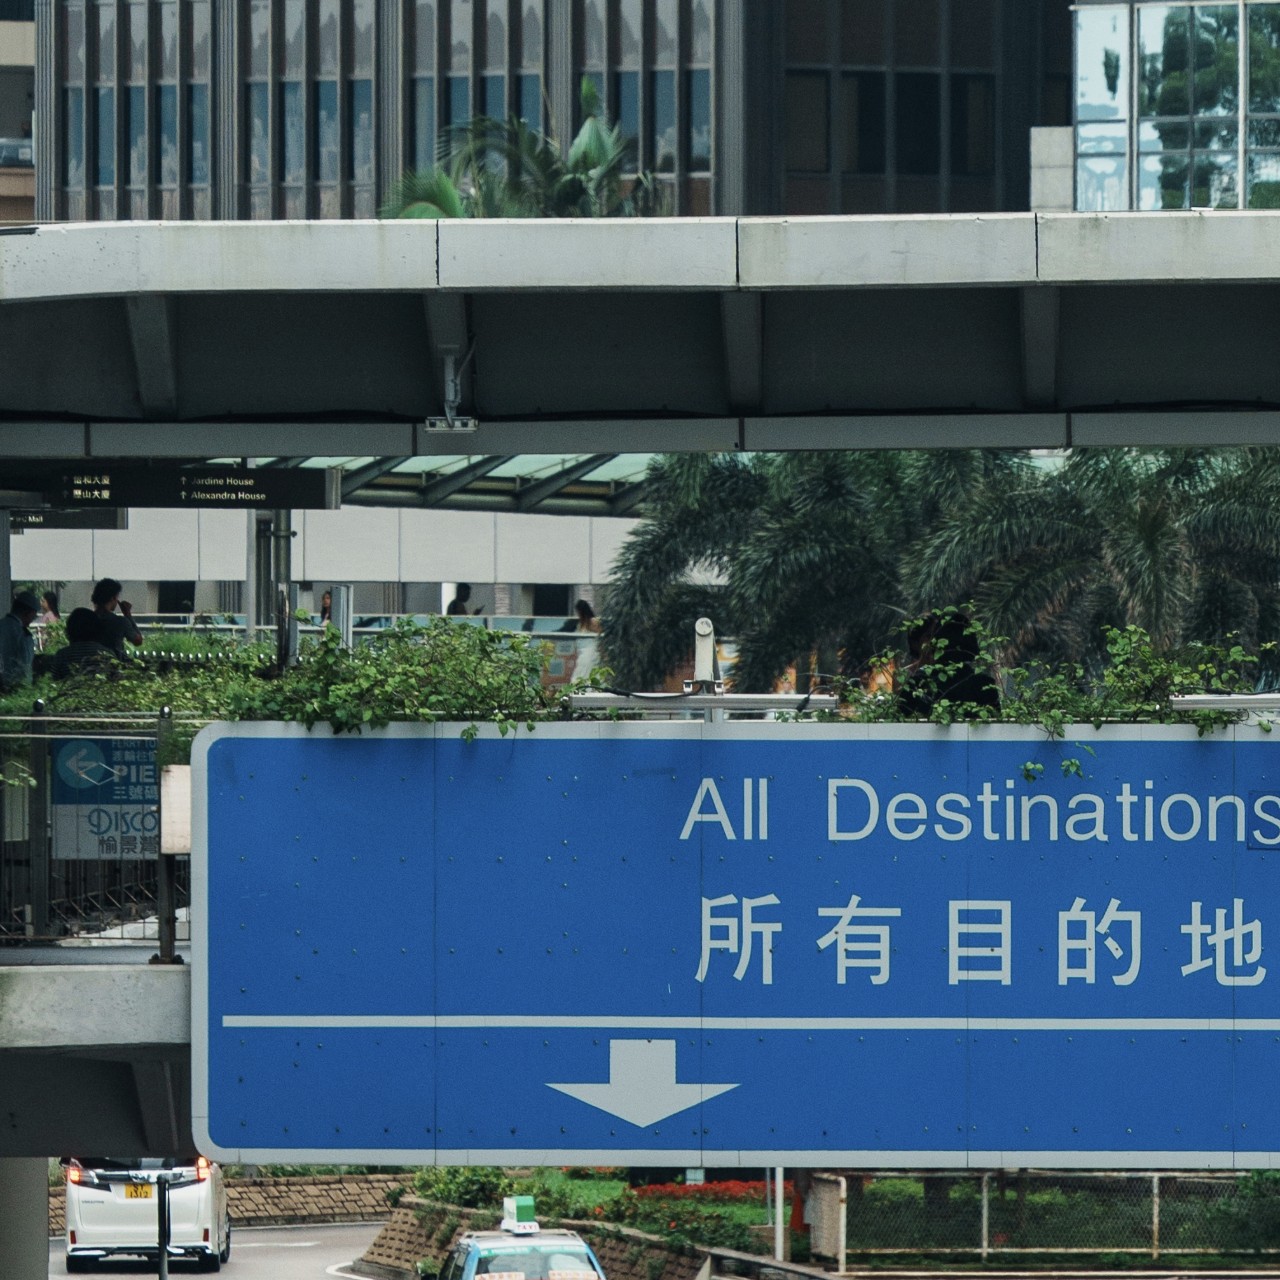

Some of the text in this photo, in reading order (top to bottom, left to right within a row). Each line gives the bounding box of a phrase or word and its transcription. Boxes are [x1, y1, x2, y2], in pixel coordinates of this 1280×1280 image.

[191, 491, 266, 500] Alexandra House
[192, 476, 254, 486] Jardine House
[680, 778, 768, 840] All
[695, 894, 1266, 986] 所有目的地
